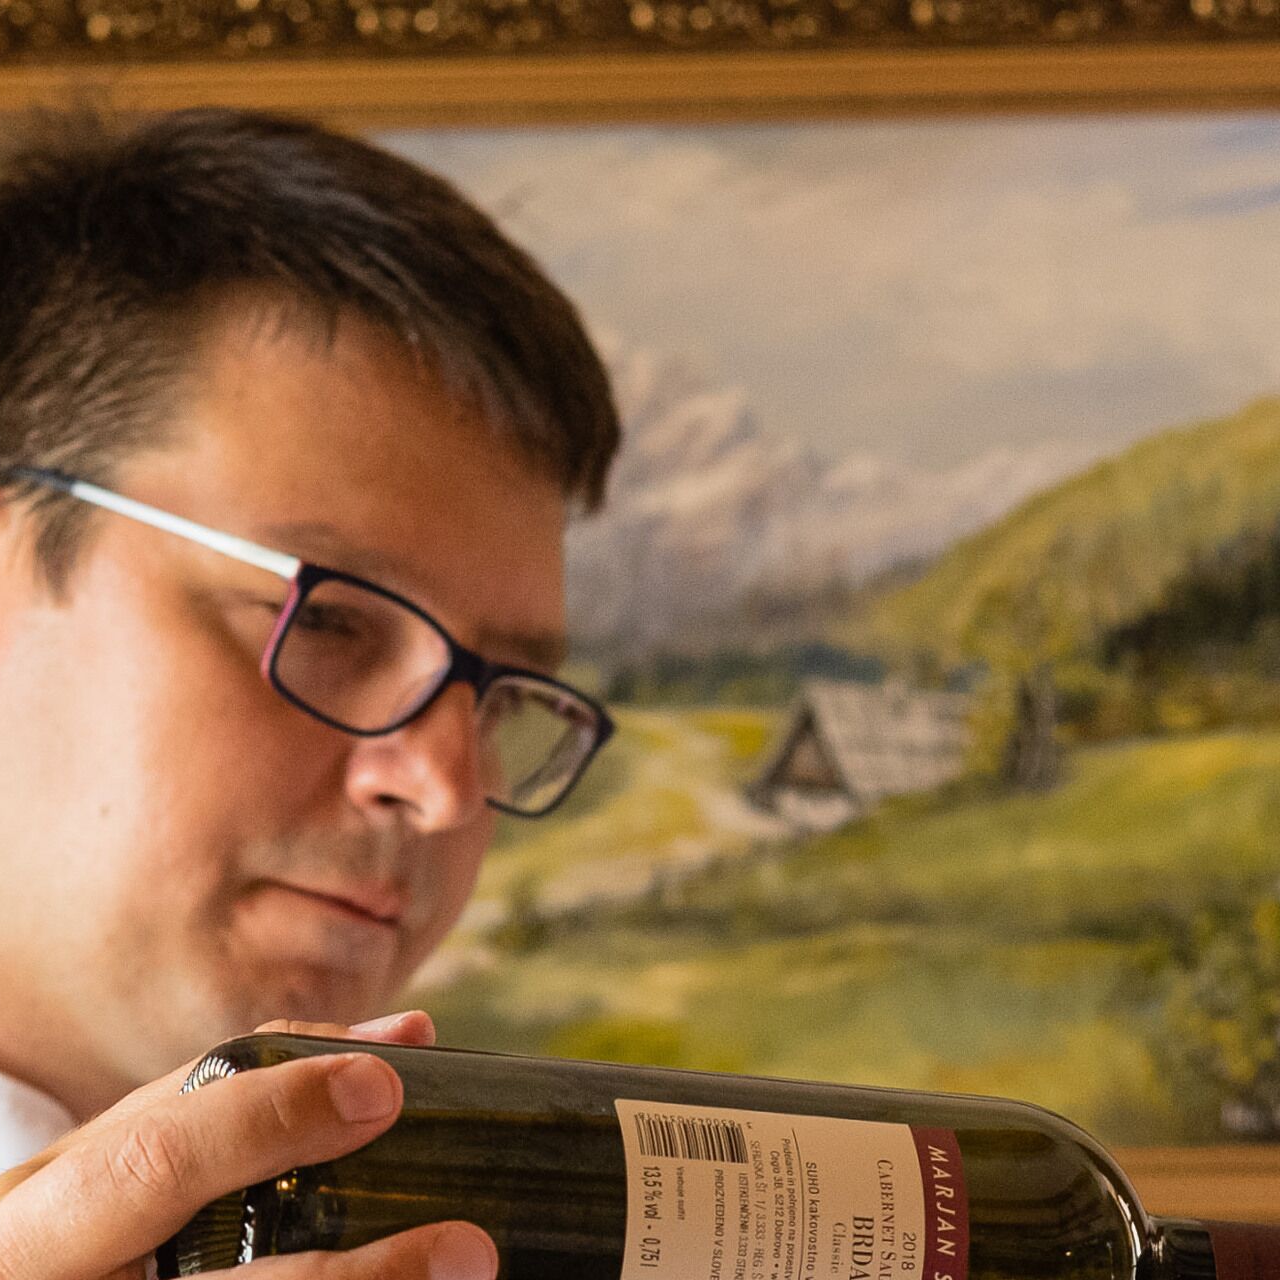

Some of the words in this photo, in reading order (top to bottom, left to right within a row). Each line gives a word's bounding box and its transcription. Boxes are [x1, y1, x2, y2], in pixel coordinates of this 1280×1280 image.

[780, 1138, 795, 1176] Pridelano
[641, 1166, 662, 1188] 13,5
[644, 1189, 663, 1201] %
[787, 1176, 795, 1186] in
[805, 1161, 820, 1195] SUHO
[644, 1203, 662, 1220] vol
[714, 1168, 725, 1237] PROIZVEDENO
[774, 1194, 785, 1217] 5212
[786, 1187, 797, 1227] polnjeno
[876, 1159, 897, 1247] CABERNET
[927, 1144, 957, 1257] MARJAN
[639, 1237, 661, 1261] 0,75
[713, 1239, 723, 1247] V
[772, 1219, 784, 1259] Dobrovo
[787, 1228, 796, 1241] na
[805, 1199, 820, 1271] kakovostno
[830, 1222, 847, 1274] Classic
[901, 1231, 917, 1271] 2018
